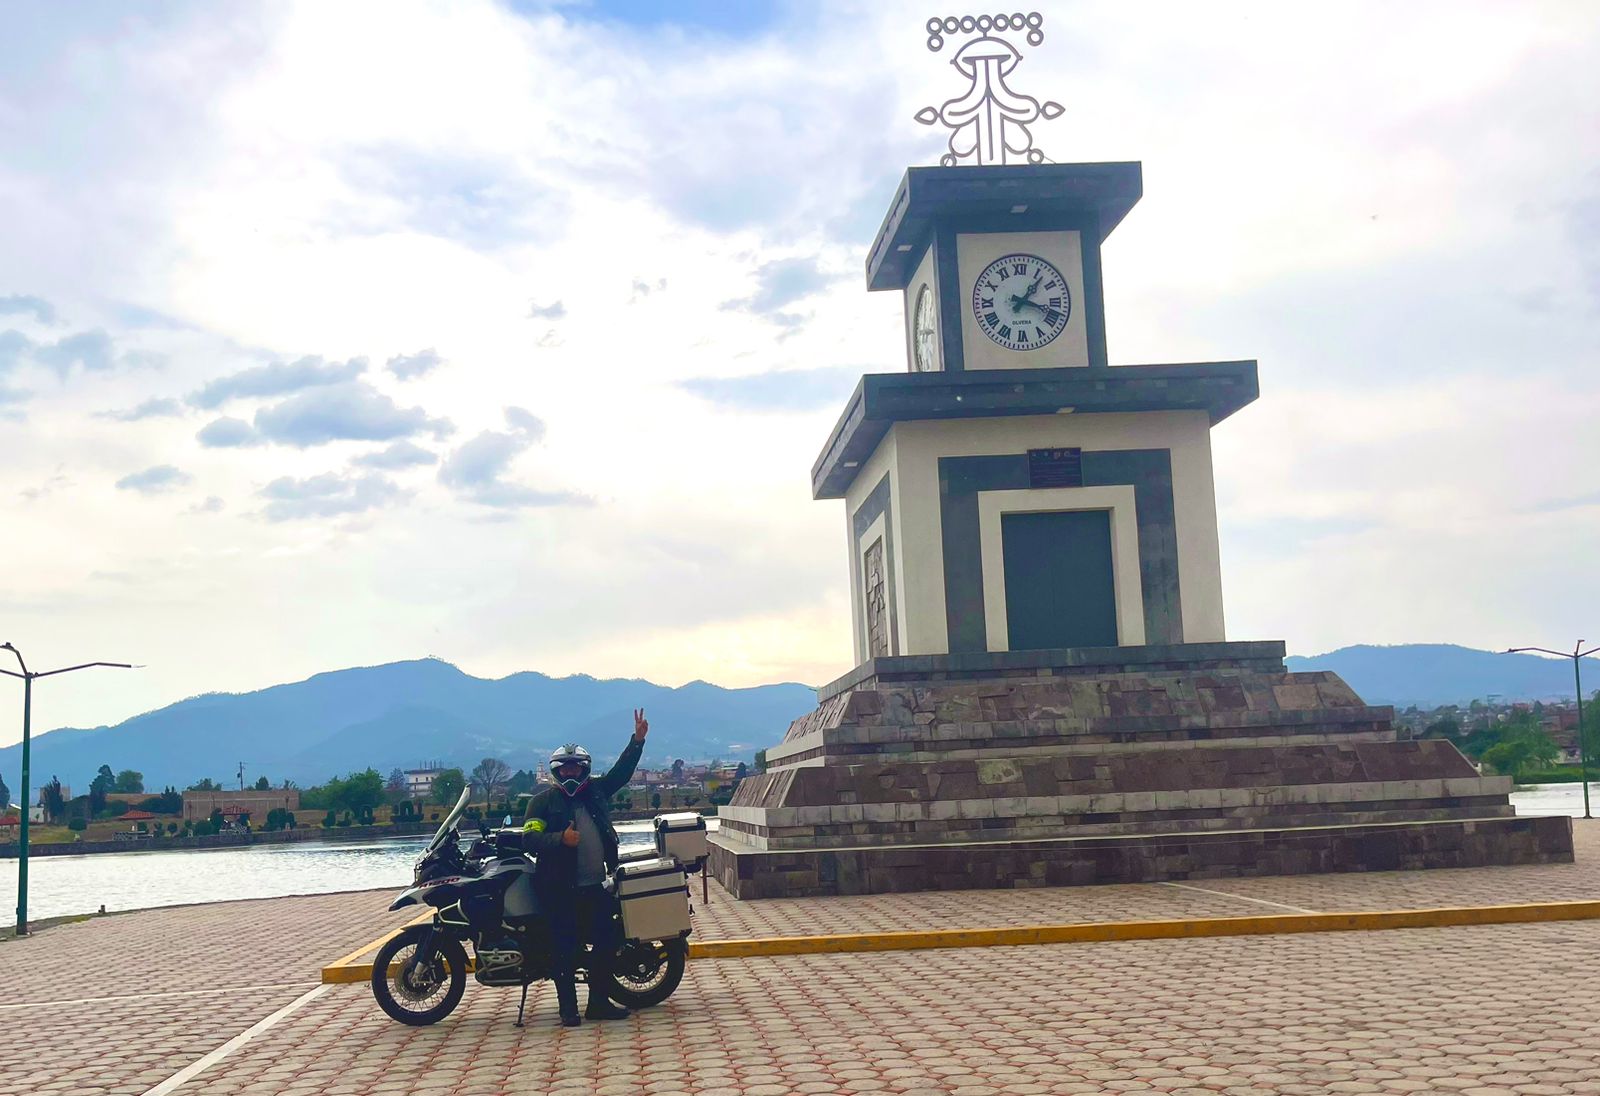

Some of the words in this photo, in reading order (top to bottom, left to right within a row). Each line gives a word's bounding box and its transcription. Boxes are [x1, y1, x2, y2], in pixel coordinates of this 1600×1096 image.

[996, 267, 1010, 281] XI
[1012, 264, 1027, 275] XII
[985, 280, 998, 292] X
[1044, 280, 1056, 291] II
[981, 297, 994, 309] IX
[1049, 297, 1061, 308] III
[984, 311, 1000, 329] VIII
[997, 324, 1011, 339] VII
[1017, 330, 1028, 342] VI
[1035, 326, 1046, 338] V
